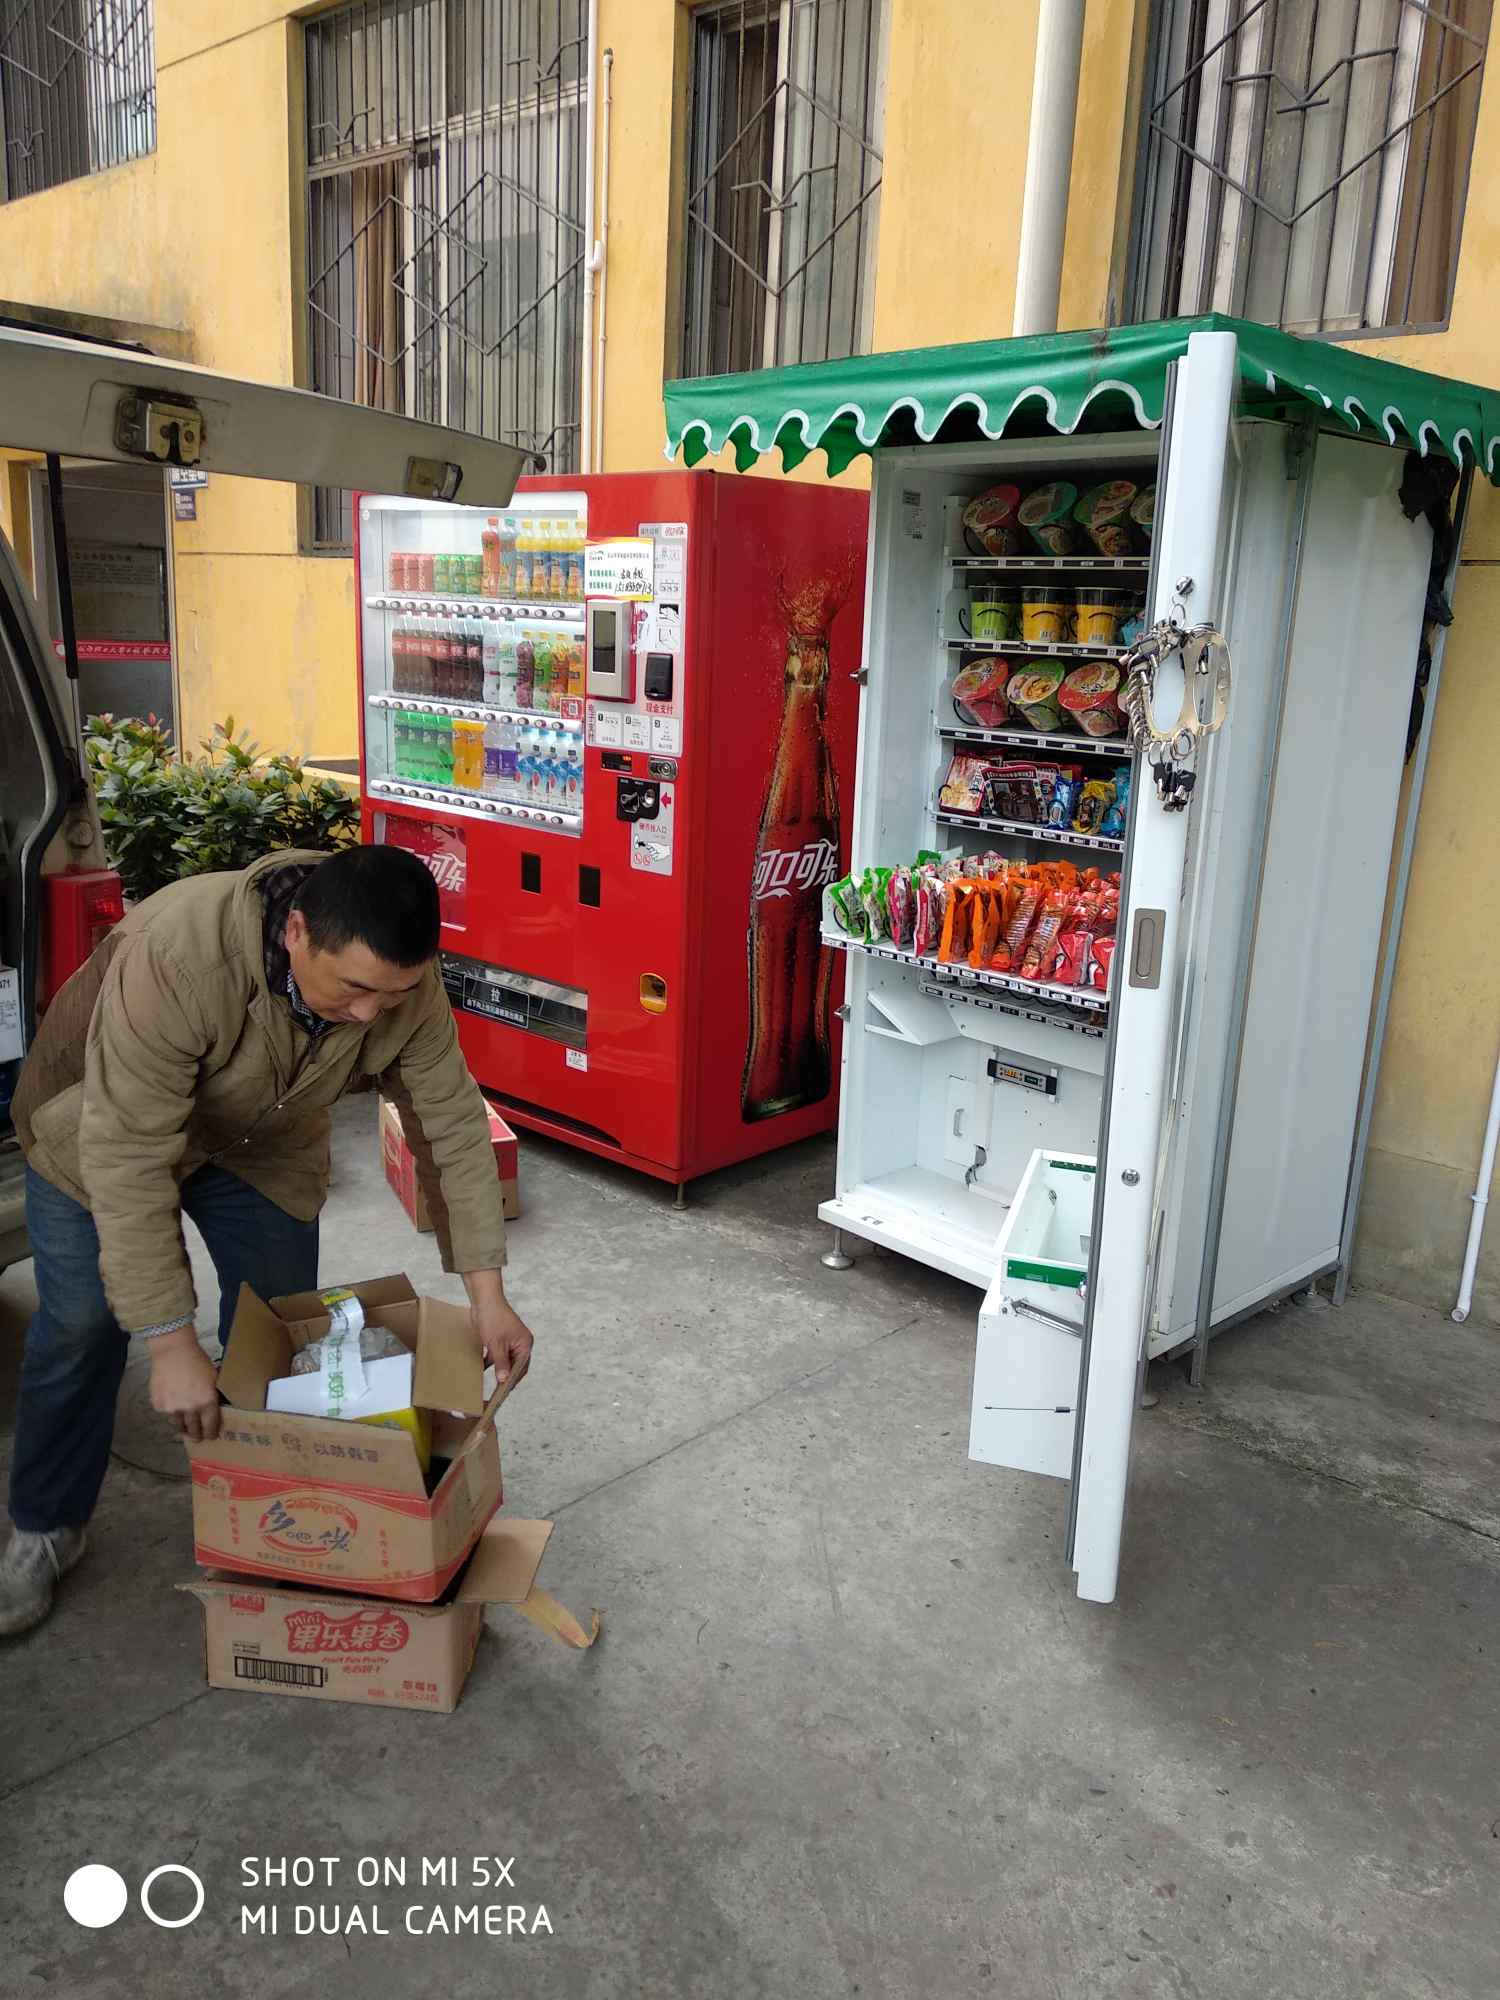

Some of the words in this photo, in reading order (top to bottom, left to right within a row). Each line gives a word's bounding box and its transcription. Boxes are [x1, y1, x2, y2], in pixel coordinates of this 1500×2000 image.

[755, 839, 839, 898] 可口可乐
[490, 987, 501, 1003] 拉
[287, 1614, 322, 1630] mini
[291, 1619, 403, 1650] 果乐果香
